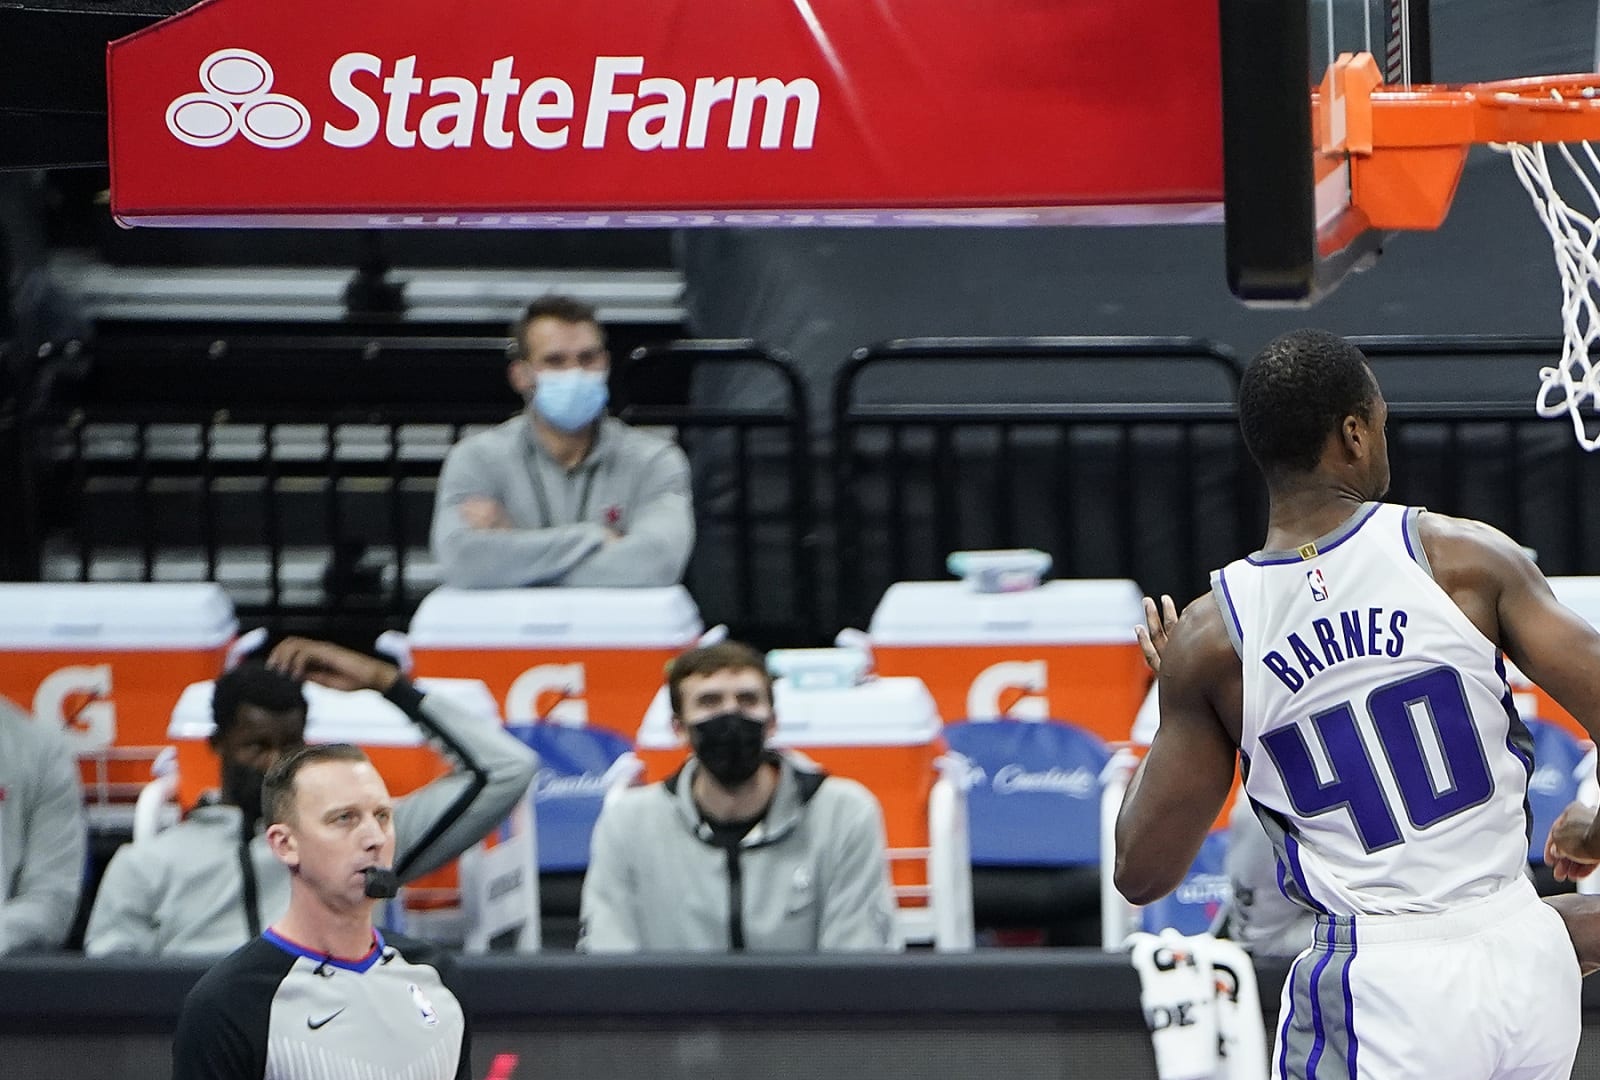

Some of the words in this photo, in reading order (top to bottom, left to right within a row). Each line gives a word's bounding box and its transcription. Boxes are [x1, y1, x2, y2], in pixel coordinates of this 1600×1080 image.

[1261, 607, 1408, 694] BARNES
[33, 663, 117, 750] G
[1257, 664, 1495, 856] 40
